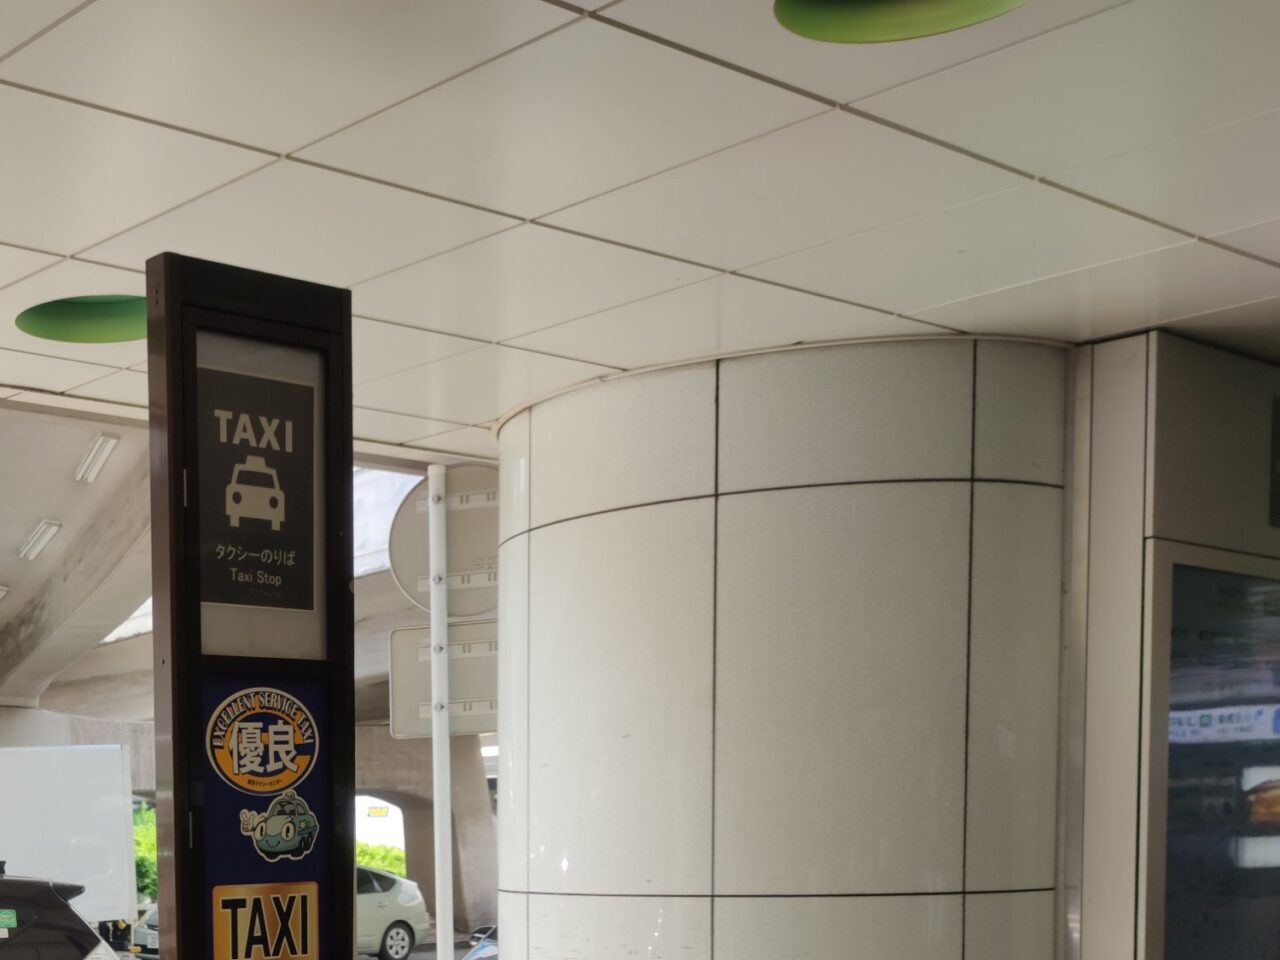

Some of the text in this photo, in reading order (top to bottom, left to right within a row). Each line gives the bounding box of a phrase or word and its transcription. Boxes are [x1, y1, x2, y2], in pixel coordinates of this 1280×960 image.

[214, 408, 294, 453] TAXI
[215, 543, 296, 567] タクシーのりば
[229, 567, 282, 586] Taxi Stop
[212, 691, 315, 747] EXCELLENT SERVICE TAXI
[228, 719, 300, 775] 優良
[221, 896, 309, 960] TAXI
